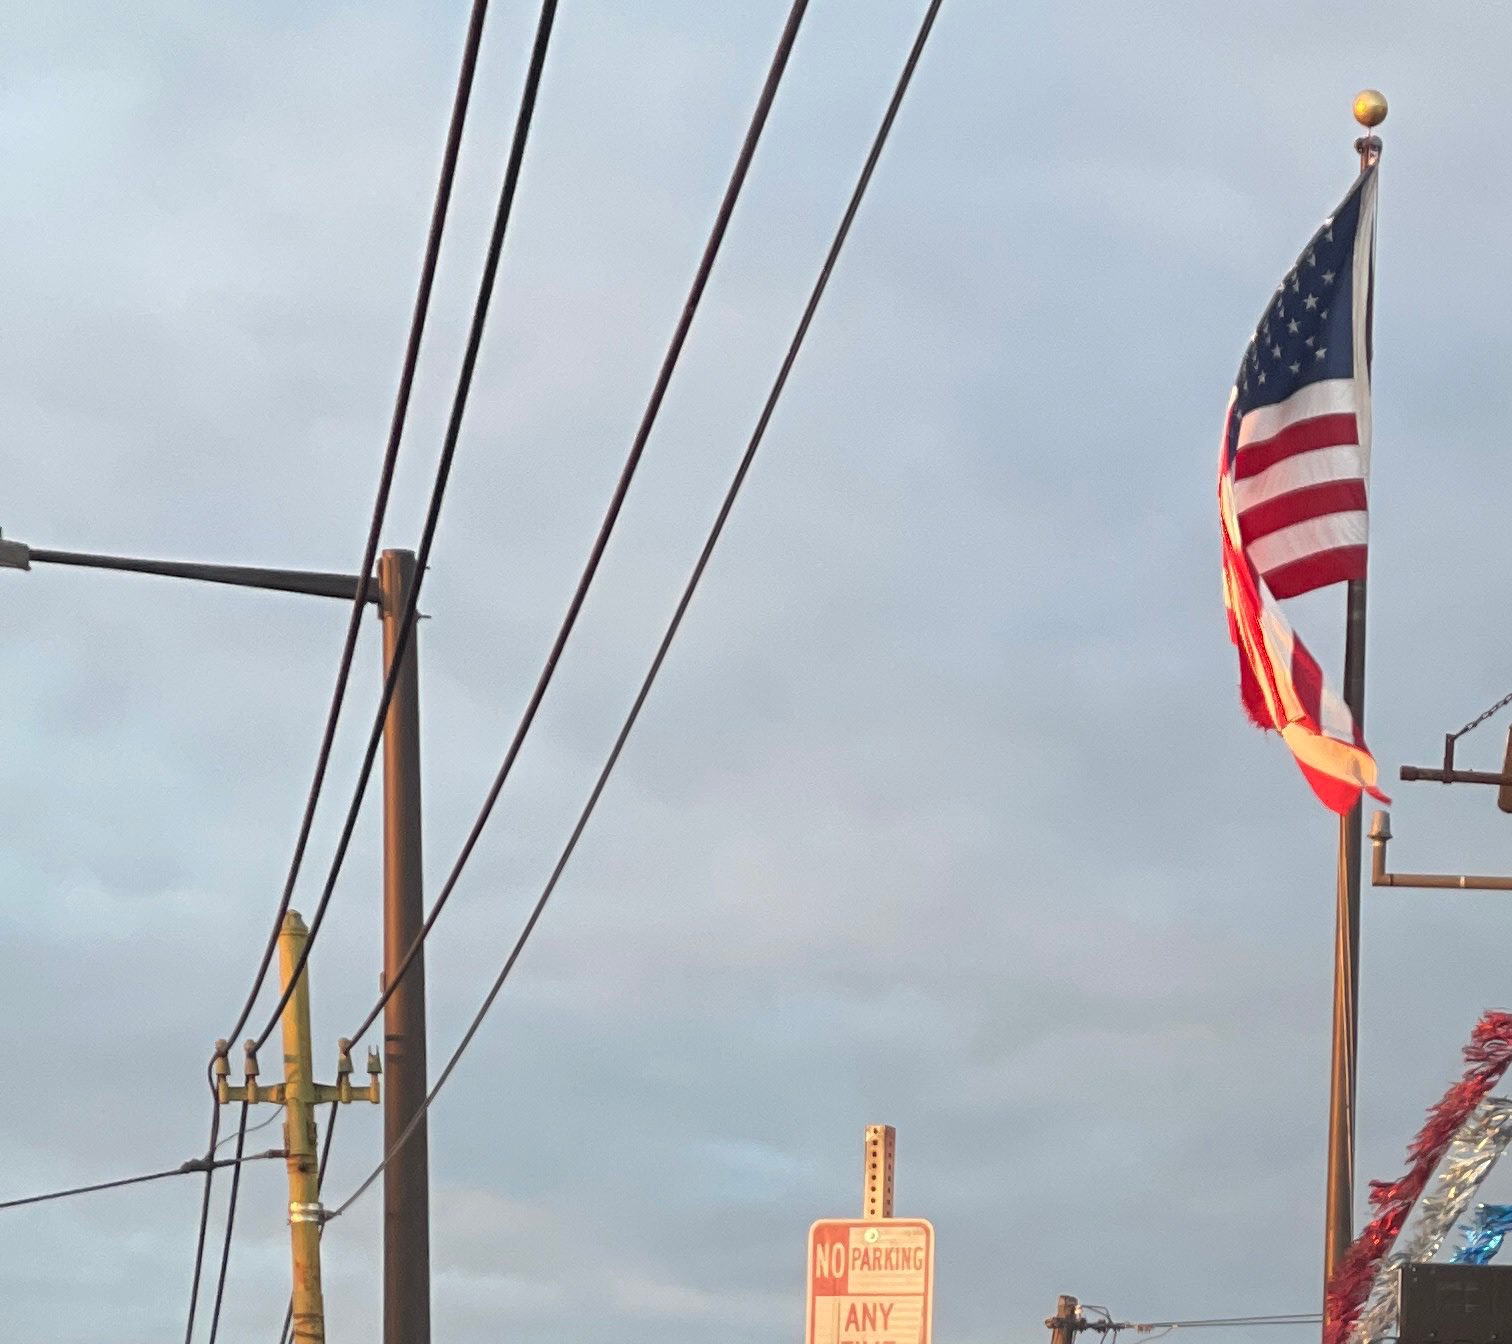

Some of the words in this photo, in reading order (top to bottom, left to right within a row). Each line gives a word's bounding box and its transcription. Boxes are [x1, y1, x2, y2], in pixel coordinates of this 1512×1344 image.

[815, 1241, 846, 1280] NO
[851, 1246, 924, 1272] PARKING
[844, 1302, 895, 1332] ANY
